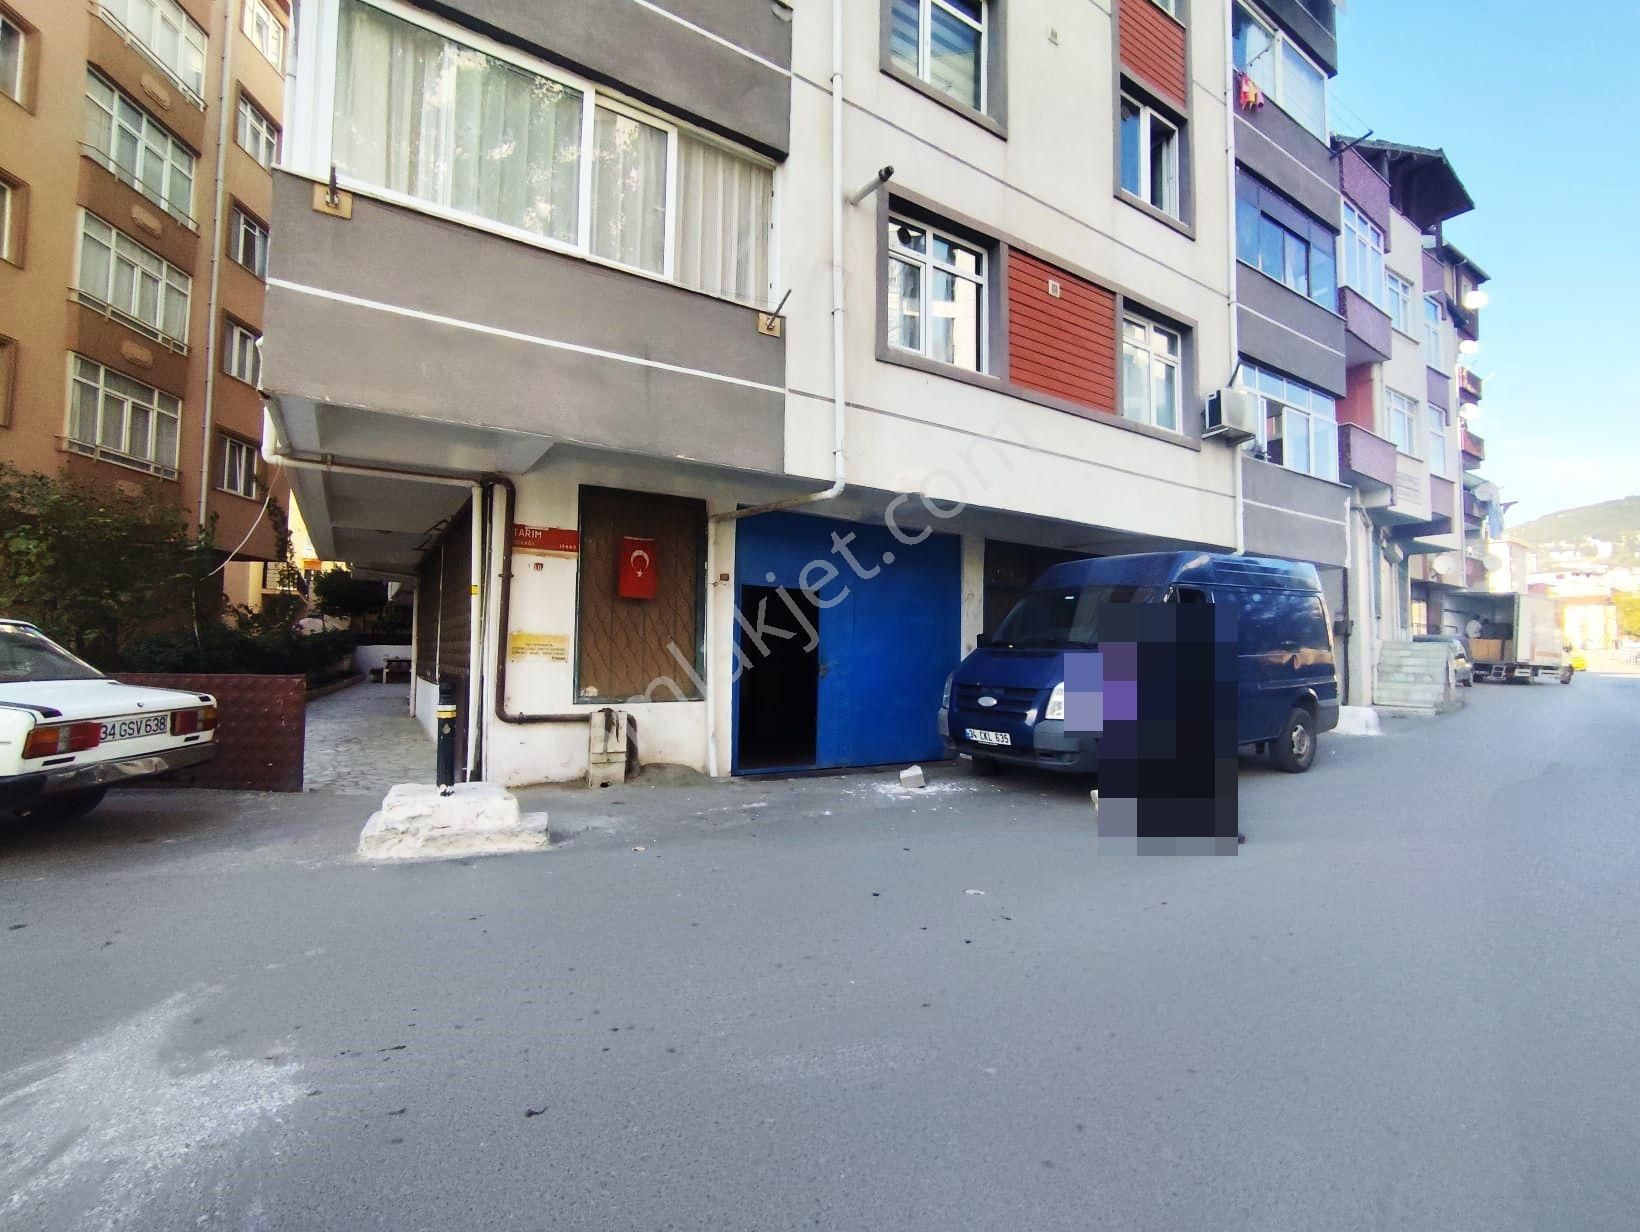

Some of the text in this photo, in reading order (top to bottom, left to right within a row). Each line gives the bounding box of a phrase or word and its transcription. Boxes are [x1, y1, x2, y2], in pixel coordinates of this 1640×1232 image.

[100, 716, 166, 740] 34 GSV 638
